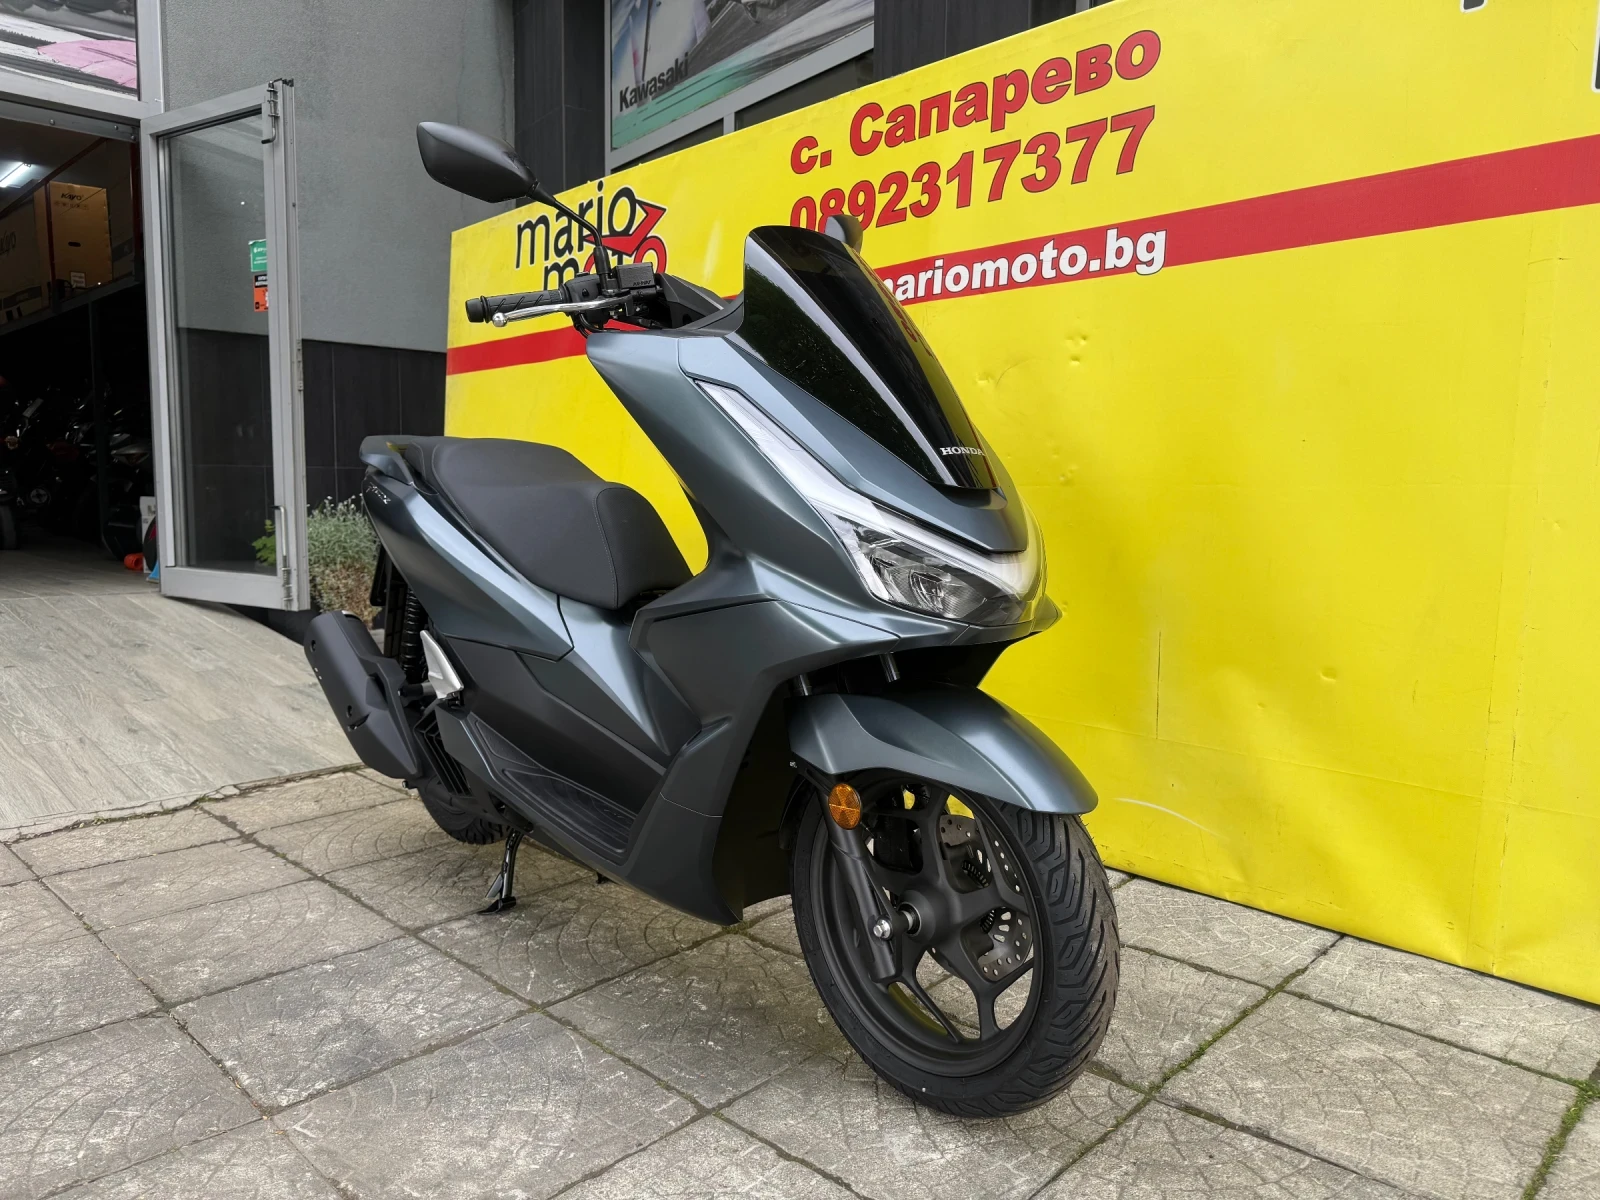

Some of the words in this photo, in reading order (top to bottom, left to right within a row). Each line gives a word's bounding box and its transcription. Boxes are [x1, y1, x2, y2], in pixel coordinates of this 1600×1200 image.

[619, 52, 689, 112] Kawasaki
[790, 136, 832, 174] с.
[850, 30, 1161, 156] Сапарево
[790, 105, 1155, 234] 0892317377
[515, 180, 637, 269] mario
[882, 228, 1168, 302] ariomoto.bg
[940, 446, 985, 456] HONDA
